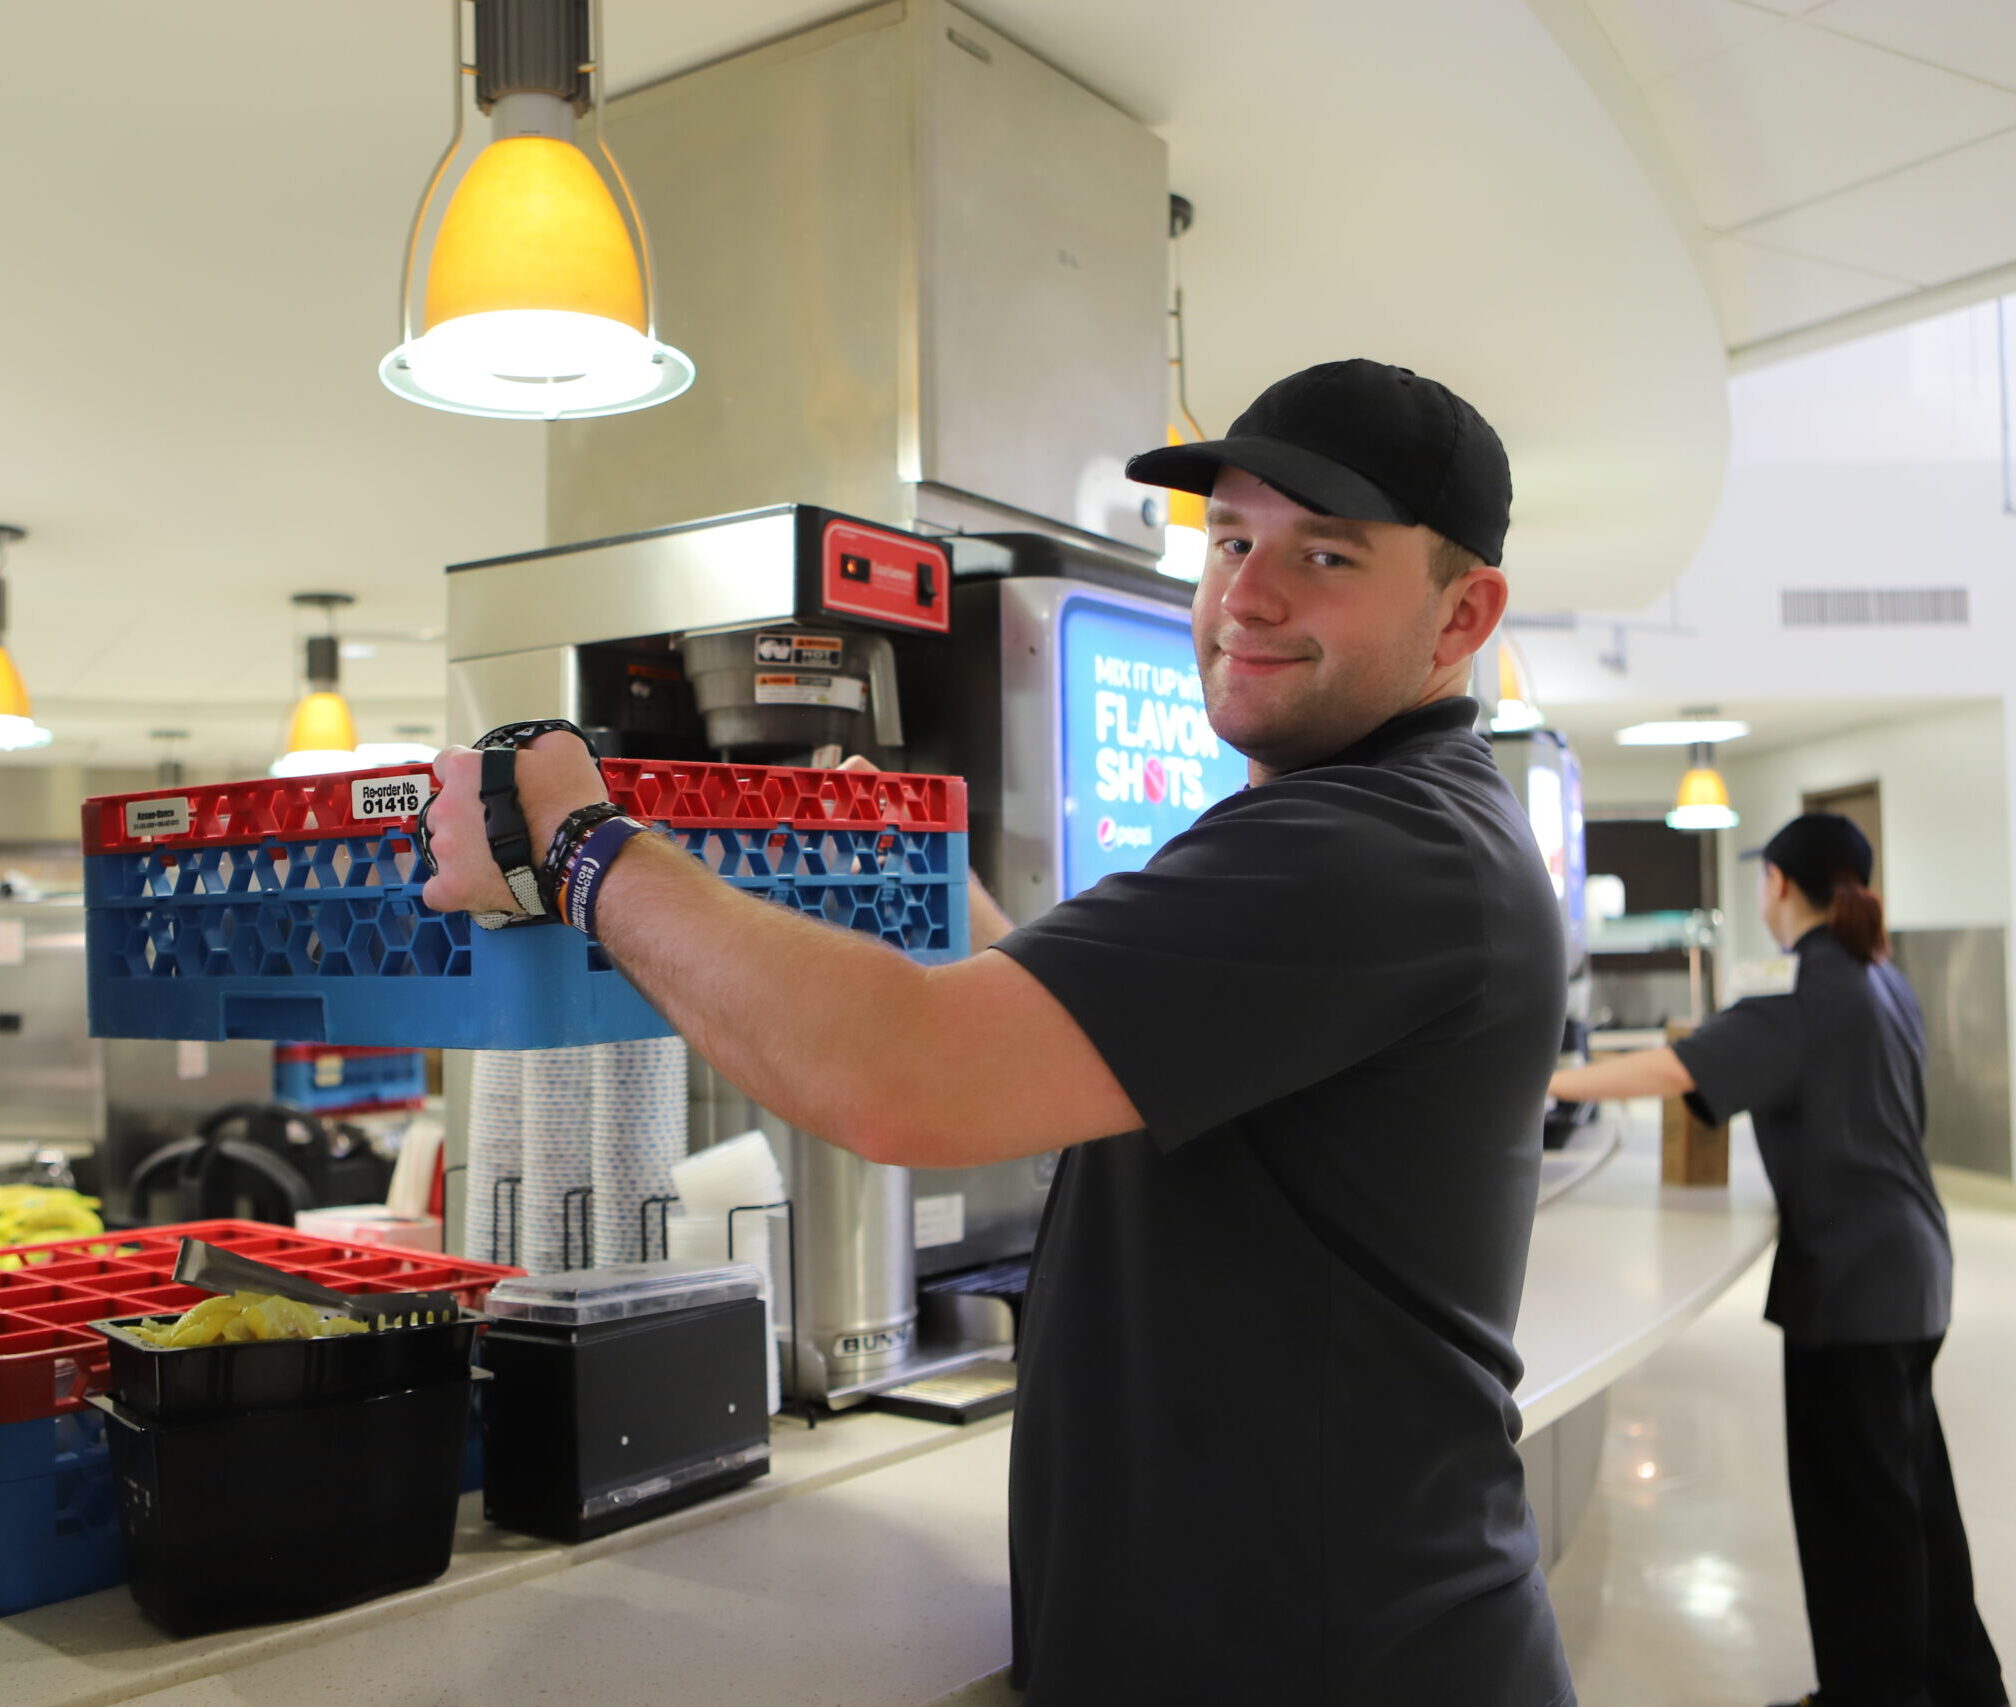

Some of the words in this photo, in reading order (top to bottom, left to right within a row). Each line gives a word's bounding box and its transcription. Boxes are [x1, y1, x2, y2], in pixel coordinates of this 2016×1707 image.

[1094, 654, 1131, 688] MIX
[1132, 662, 1151, 691] IT
[1152, 666, 1177, 696] UP
[362, 784, 401, 798] Re-order
[402, 782, 418, 795] No.
[1095, 747, 1204, 810] SHOTS
[362, 796, 419, 815] 01419
[577, 865, 590, 884] FOR
[579, 867, 596, 905] CANCER
